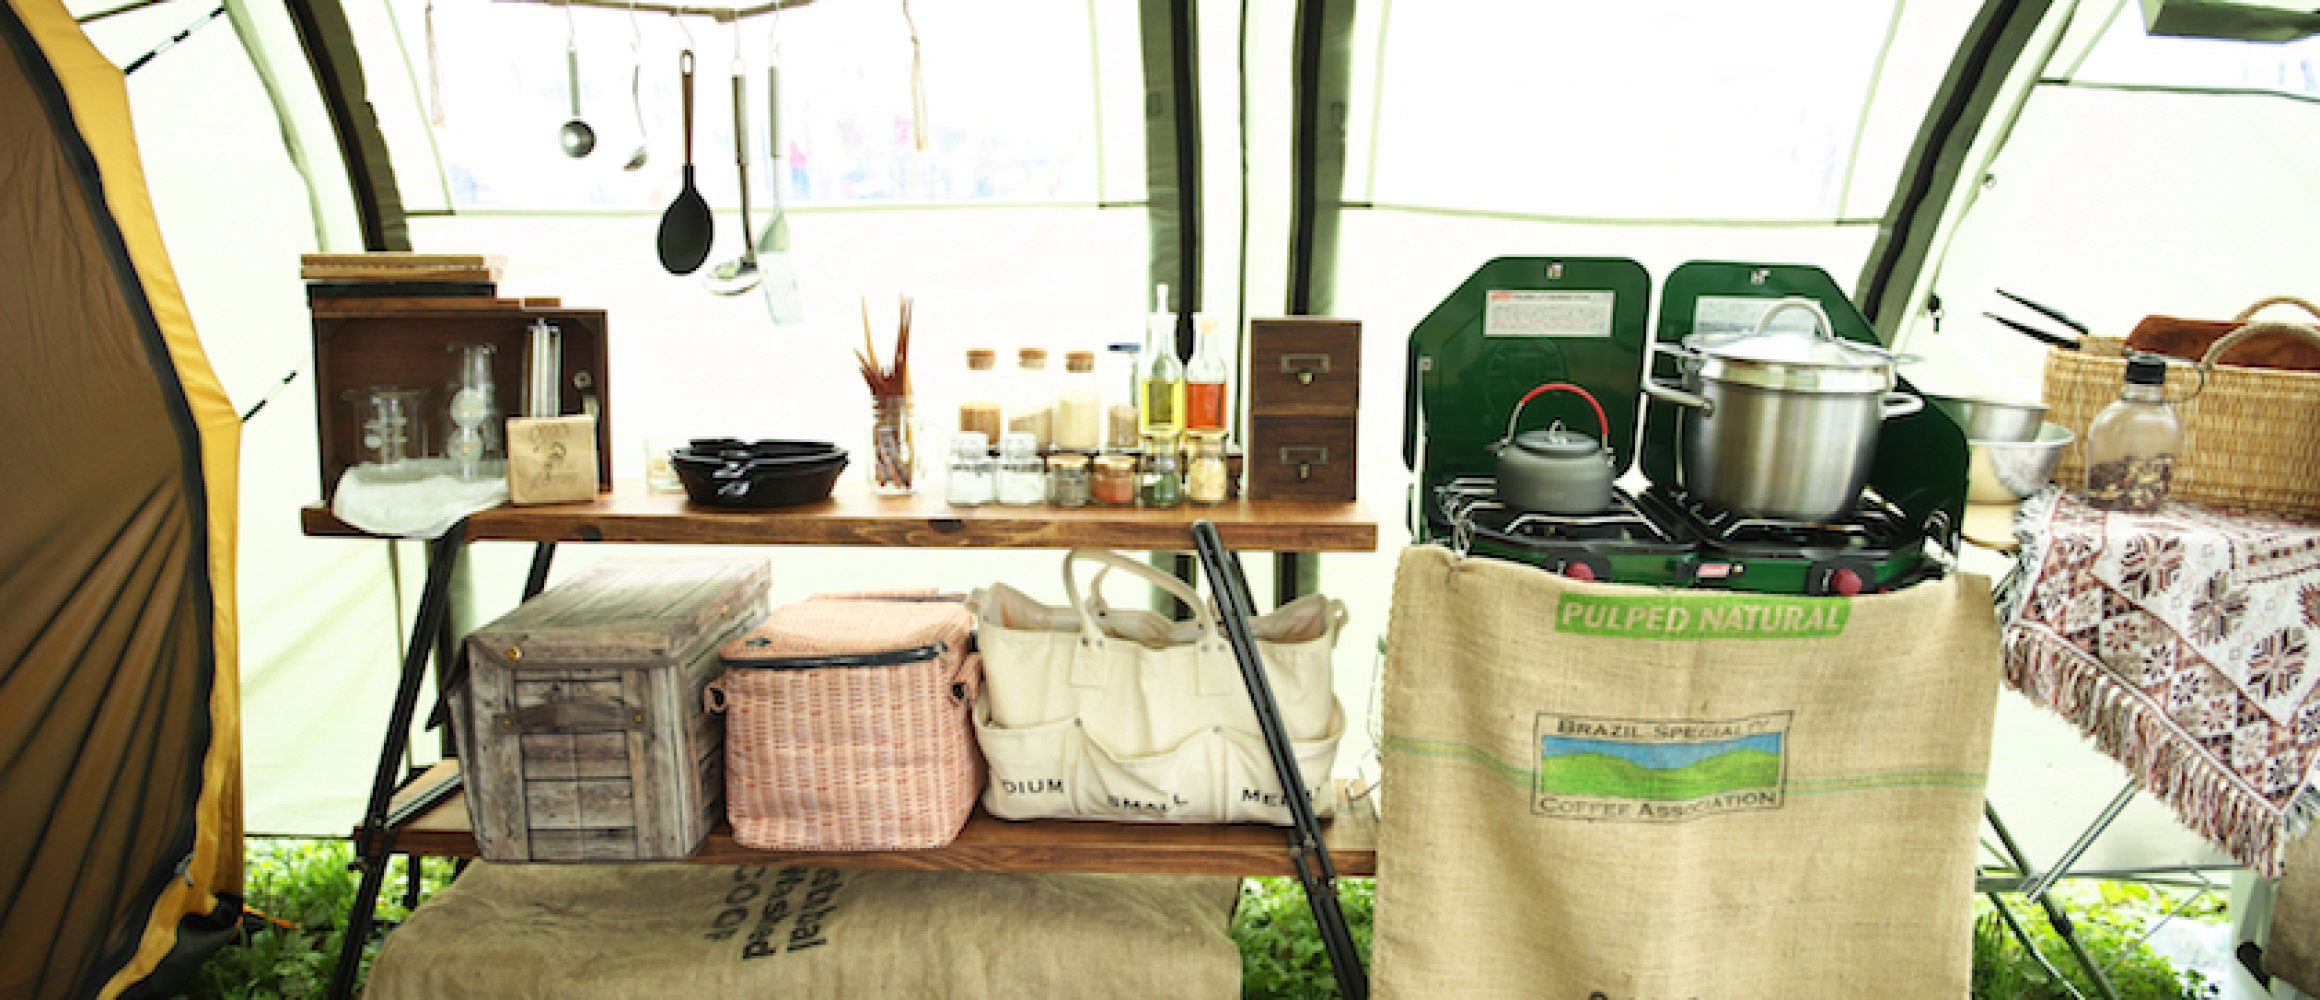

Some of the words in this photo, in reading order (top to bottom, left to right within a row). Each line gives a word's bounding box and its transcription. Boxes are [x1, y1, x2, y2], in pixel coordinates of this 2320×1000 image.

[1562, 602, 1690, 633] PULPED
[1699, 603, 1840, 633] NATURAL
[1557, 719, 1637, 737] BRAZIL
[1539, 796, 1632, 816] COFFEE
[1638, 792, 1777, 817] ASSOCIATION
